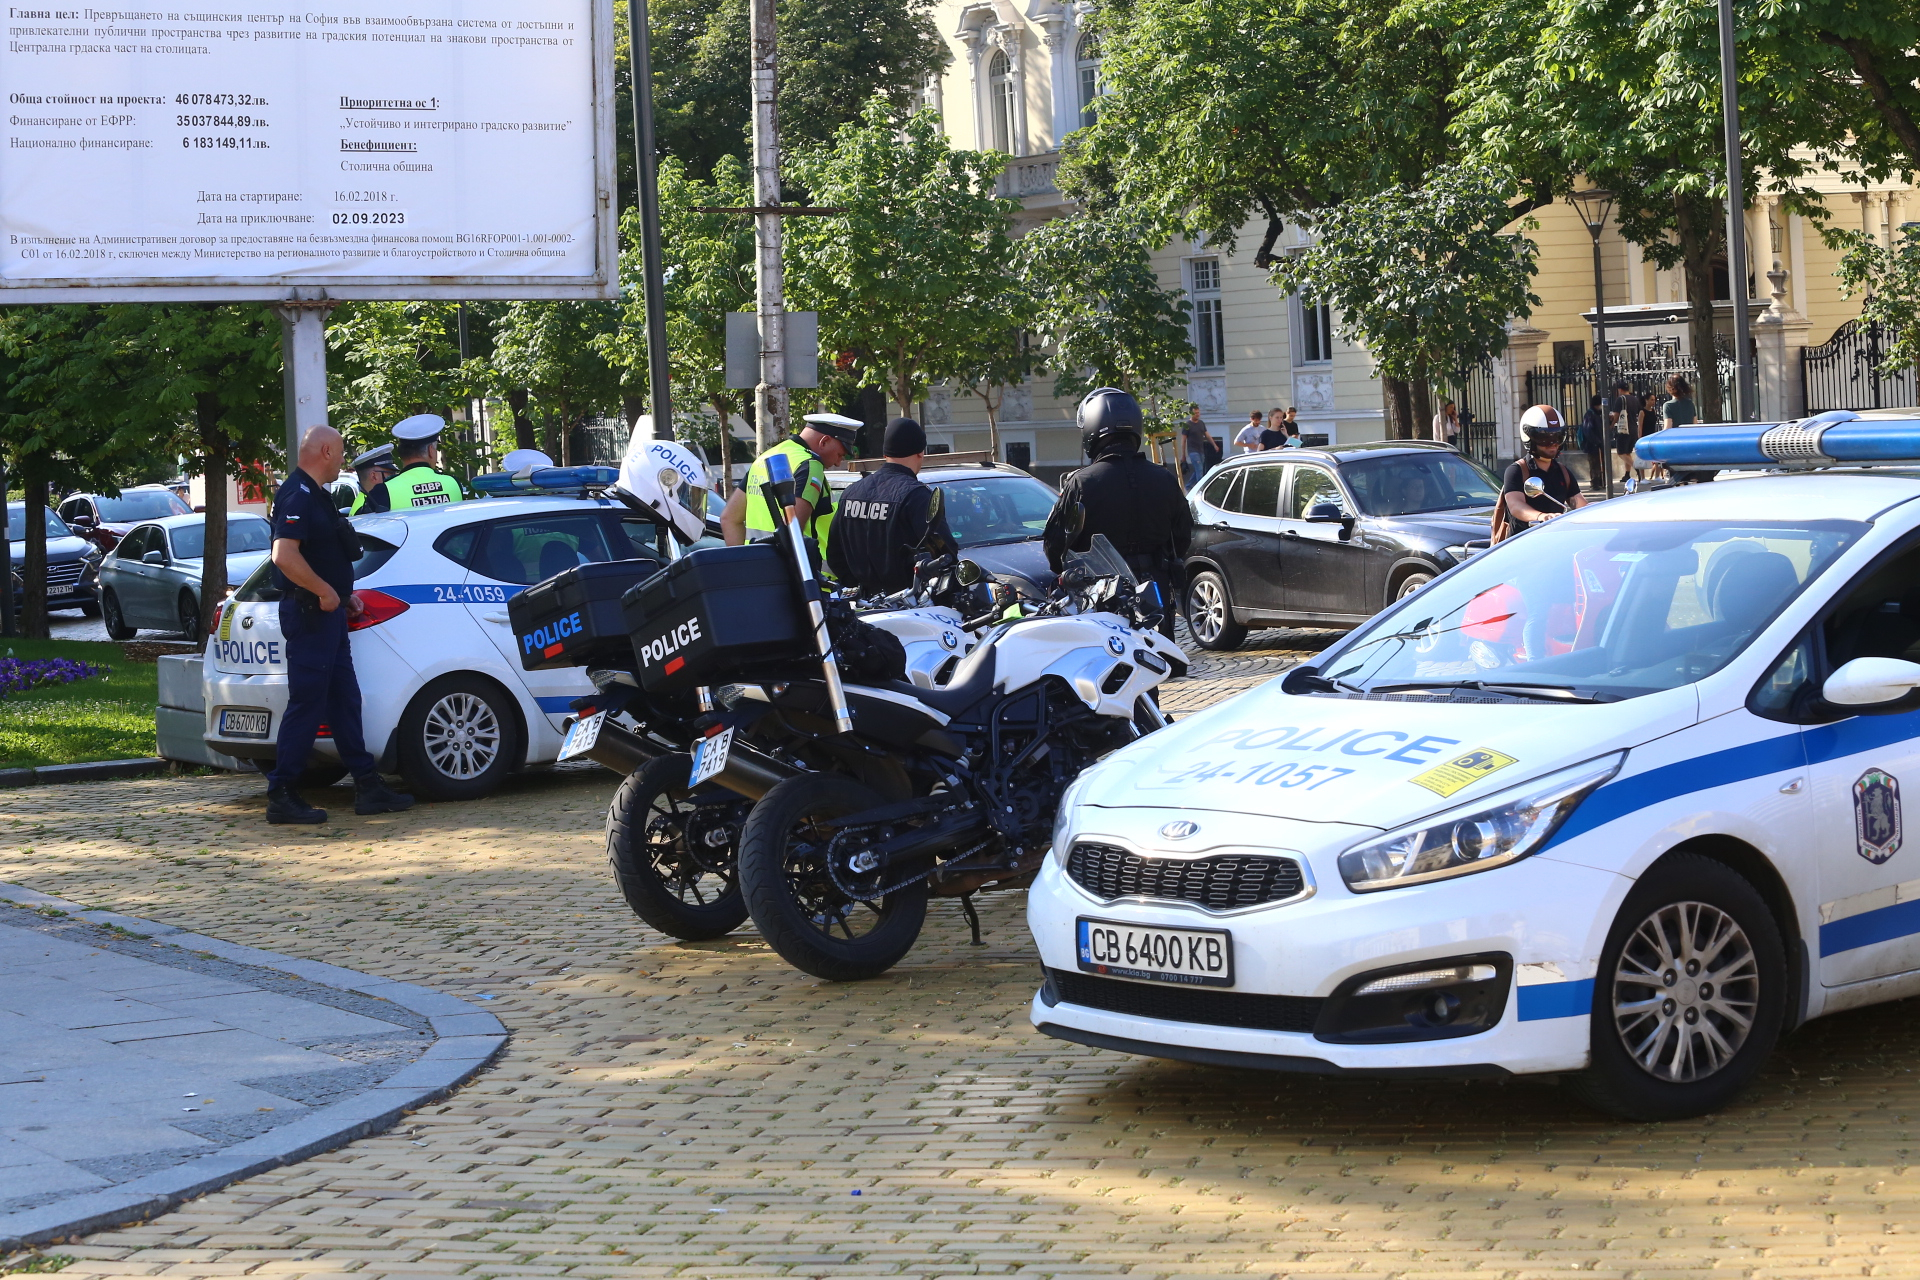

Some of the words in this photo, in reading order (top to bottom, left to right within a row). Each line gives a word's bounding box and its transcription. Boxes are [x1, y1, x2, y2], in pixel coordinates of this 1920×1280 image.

[10, 8, 50, 18] Главна
[56, 11, 78, 19] цел:
[85, 9, 162, 22] Превръщането
[184, 14, 242, 22] същинския
[248, 15, 284, 25] център
[306, 13, 338, 26] София
[366, 16, 453, 29] взаимообвързана
[457, 20, 496, 28] система
[10, 28, 88, 38] привлекателни
[95, 26, 146, 39] публични
[152, 29, 221, 40] пространства
[227, 31, 249, 41] чрез
[254, 31, 301, 41] развитие
[322, 33, 366, 43] градския
[372, 34, 425, 43] потенциал
[492, 37, 558, 47] пространства
[10, 41, 66, 55] Централна
[70, 45, 110, 55] грдаска
[155, 46, 210, 54] столицата.
[10, 93, 42, 105] Обща
[46, 94, 96, 104] стойност
[100, 96, 113, 104] на
[117, 96, 165, 107] проекта:
[340, 96, 413, 110] Приоритетна
[415, 100, 426, 108] ос
[431, 97, 439, 108] 1:
[10, 115, 82, 128] Финансиране
[86, 118, 97, 126] от
[101, 115, 135, 125] ЕФРР:
[340, 118, 401, 129] „Устойчиво
[414, 122, 477, 132] интегрирано
[481, 123, 519, 132] градско
[522, 121, 571, 132] развитие”
[11, 137, 76, 149] Национално
[80, 137, 153, 151] финансиране:
[340, 139, 417, 152] Бенефициент:
[341, 161, 390, 171] Столична
[393, 161, 433, 172] община
[197, 191, 222, 203] Дата
[240, 194, 302, 204] стартиране:
[335, 191, 387, 201] 16.02.2018
[197, 213, 222, 225] Дата
[241, 215, 314, 226] приключване:
[333, 213, 404, 224] 02.09.2023
[11, 235, 17, 244] В
[93, 235, 176, 246] Административен
[179, 237, 216, 246] договор
[231, 236, 293, 246] предоставяне
[310, 234, 369, 243] безвъзмездна
[371, 234, 419, 245] финансова
[57, 249, 105, 258] 16.02.2018
[162, 251, 191, 260] между
[194, 249, 261, 260] Министерство
[277, 250, 340, 260] регионалното
[343, 250, 380, 259] развитие
[391, 248, 476, 259] благоустройството
[488, 248, 528, 256] Столична
[531, 248, 565, 257] община
[651, 445, 697, 483] POLICE
[413, 482, 441, 493] СДВР
[412, 495, 449, 507] ПЪТНА
[844, 499, 889, 520] POLICE
[433, 586, 506, 602] 24-1059
[522, 612, 583, 655] POLICE
[640, 617, 702, 668] POLICE
[222, 640, 282, 664] POLICE
[1187, 726, 1462, 765] POLICE
[1164, 760, 1357, 791] 24-1057
[1111, 968, 1151, 979] www.kia.bg
